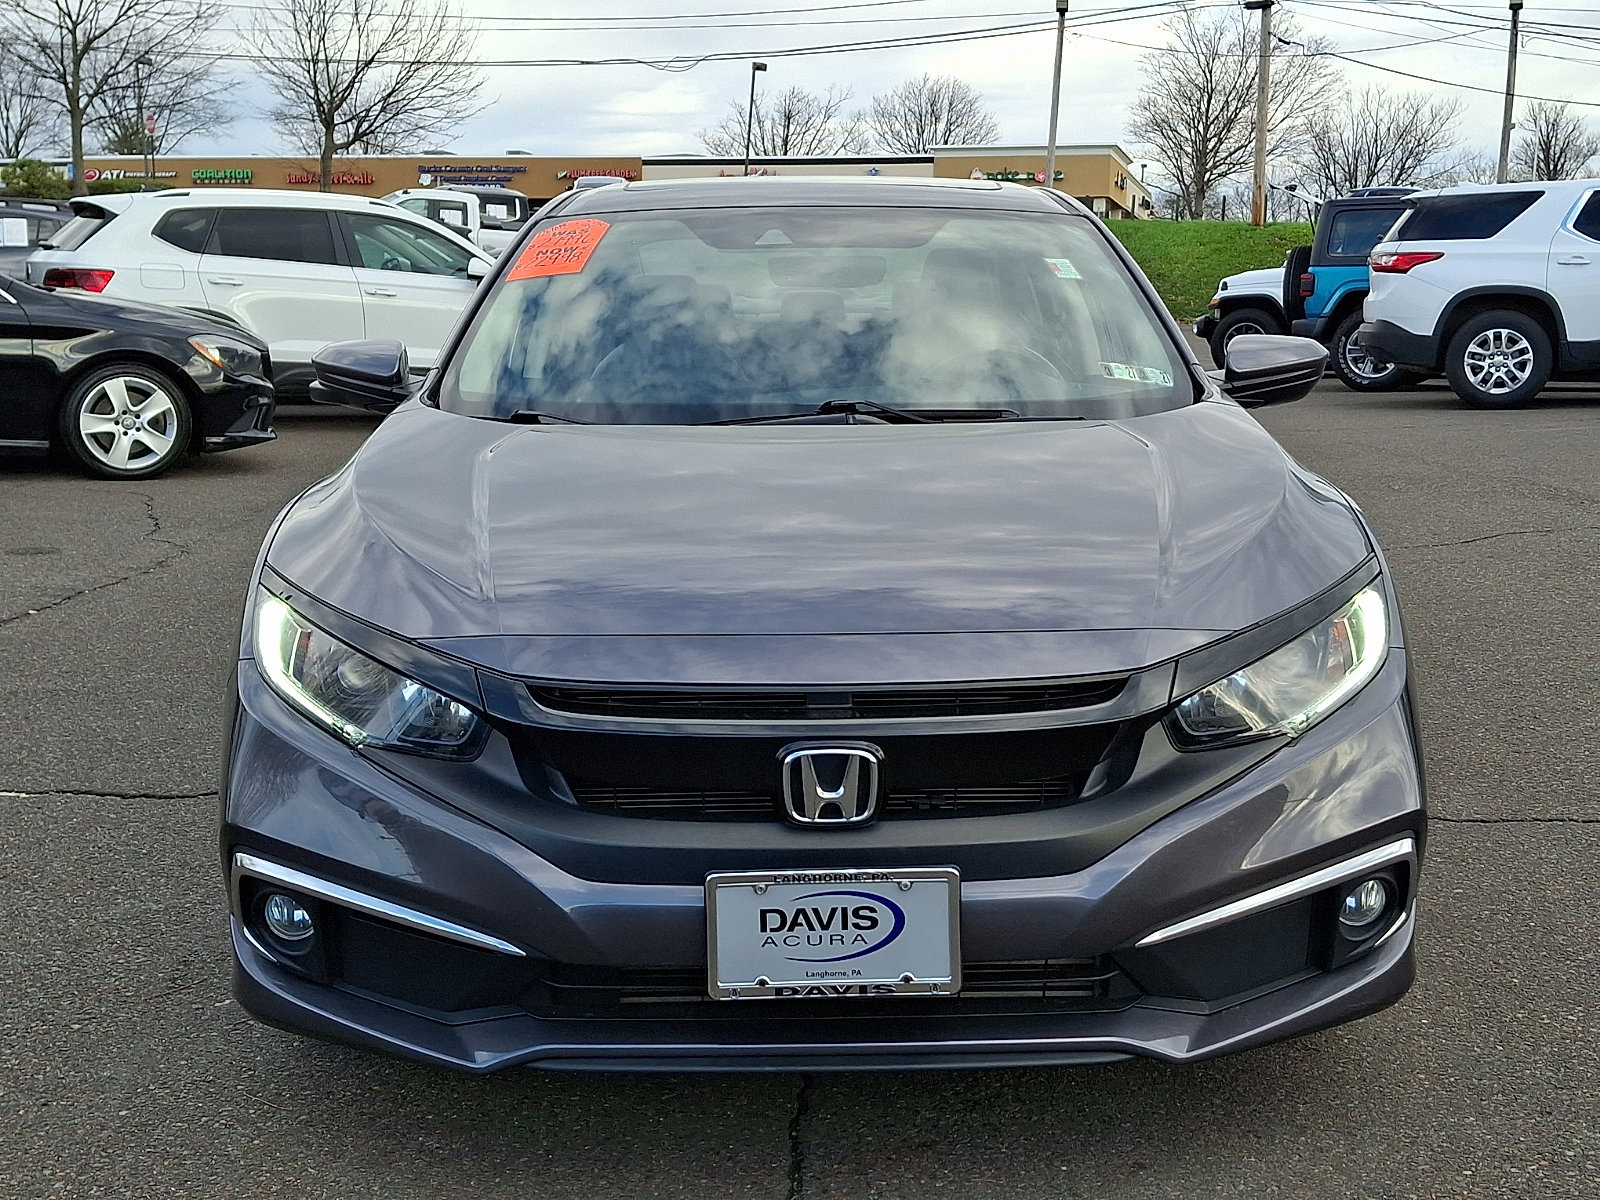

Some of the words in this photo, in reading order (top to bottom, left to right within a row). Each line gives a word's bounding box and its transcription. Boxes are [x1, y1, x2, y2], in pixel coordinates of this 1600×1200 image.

[101, 169, 124, 180] ATI
[191, 169, 252, 179] COALITION
[567, 169, 586, 178] PLUM
[605, 169, 635, 178] GARDEN
[536, 245, 580, 256] NOW
[759, 905, 879, 934] DAVIS
[761, 933, 869, 948] ACURA
[805, 970, 850, 979] Langhorne,
[851, 969, 863, 977] PA
[774, 984, 897, 997] DAVIS
